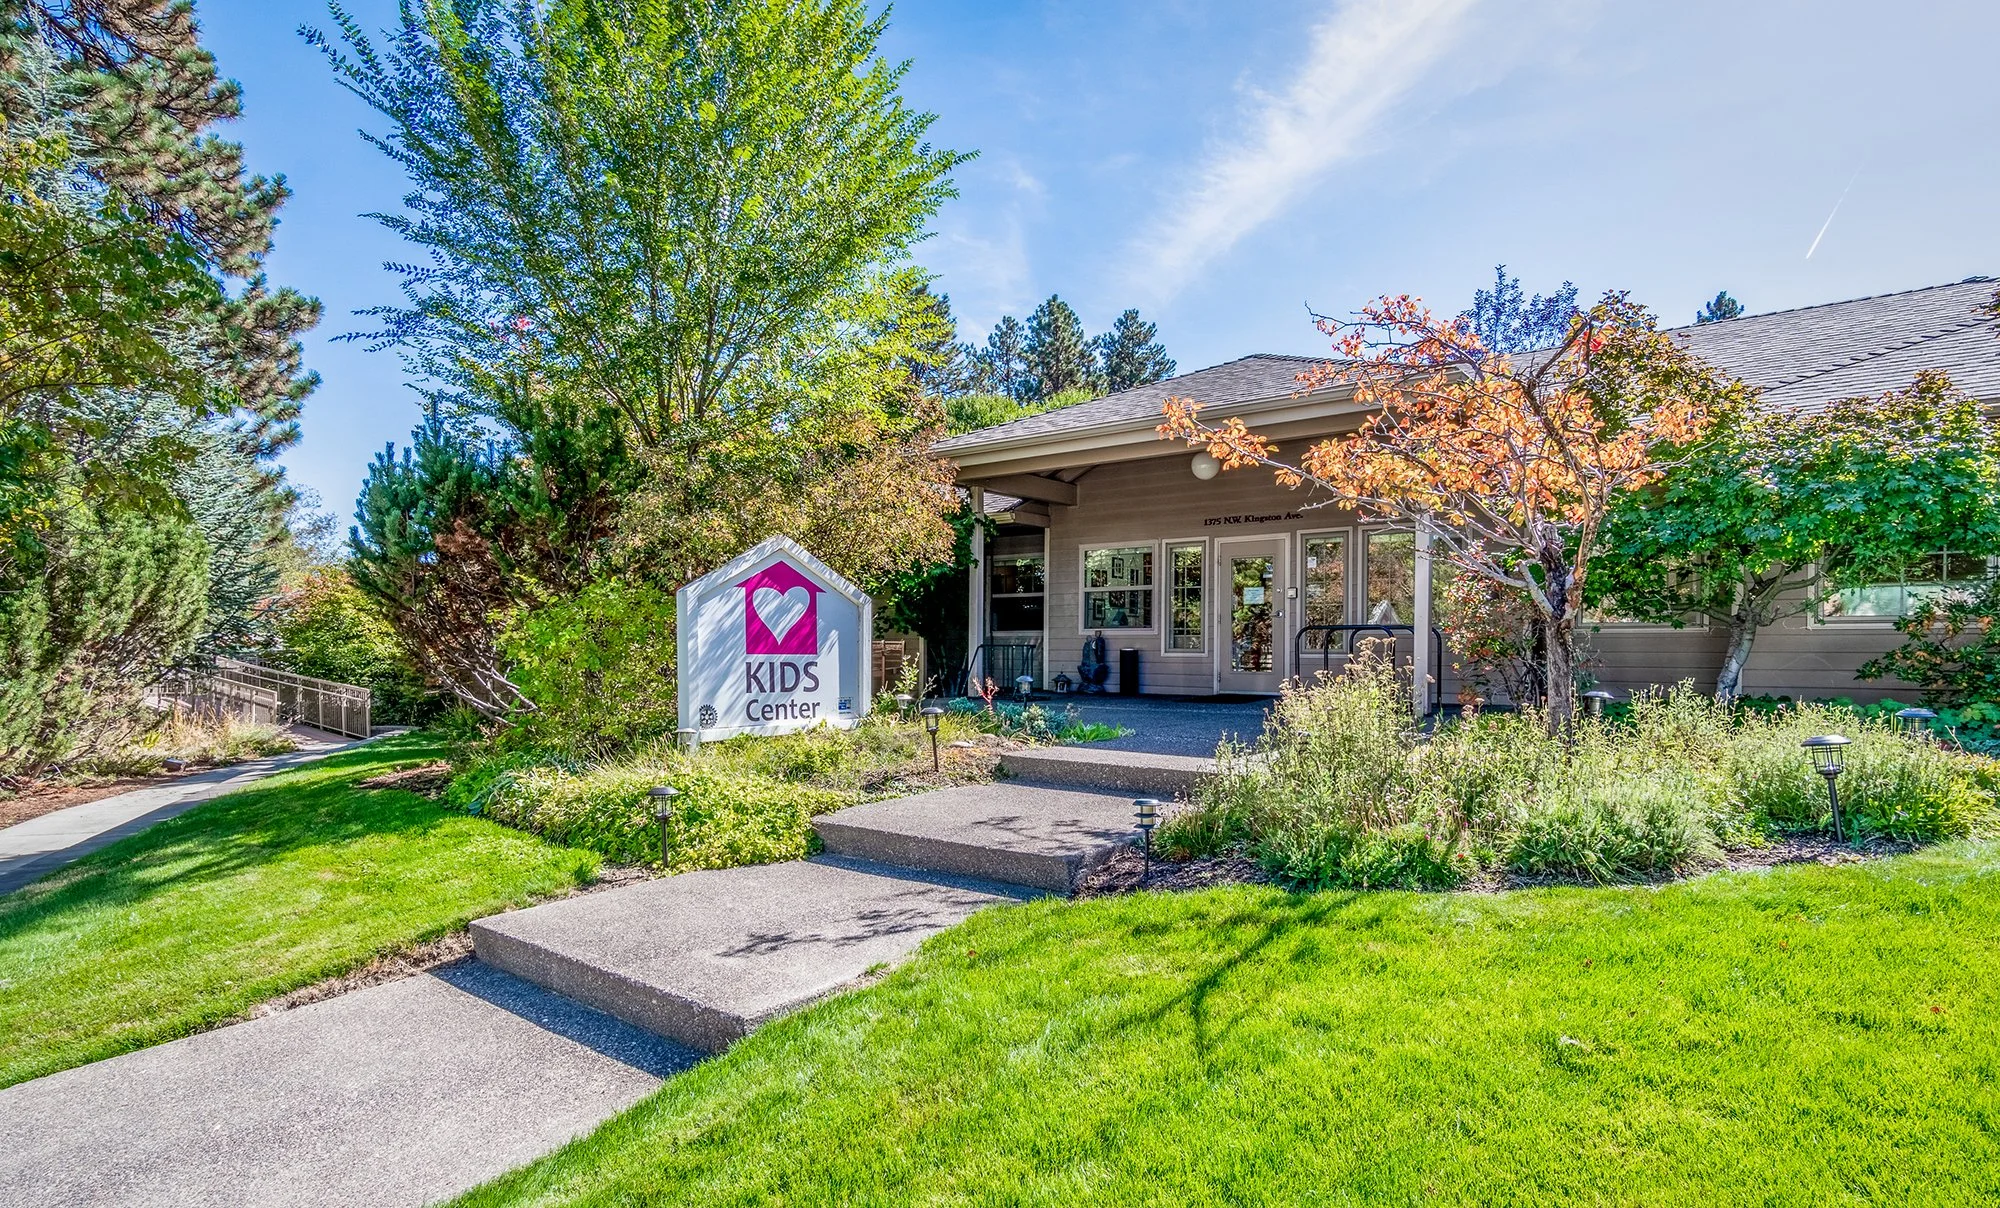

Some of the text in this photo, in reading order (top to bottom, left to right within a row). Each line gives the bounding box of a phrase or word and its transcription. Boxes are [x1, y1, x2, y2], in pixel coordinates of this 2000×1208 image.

[1204, 518, 1221, 526] 1375
[1244, 514, 1282, 523] Kingston
[1285, 511, 1304, 520] Ave.
[745, 661, 820, 693] KIDS
[745, 698, 821, 722] Center
